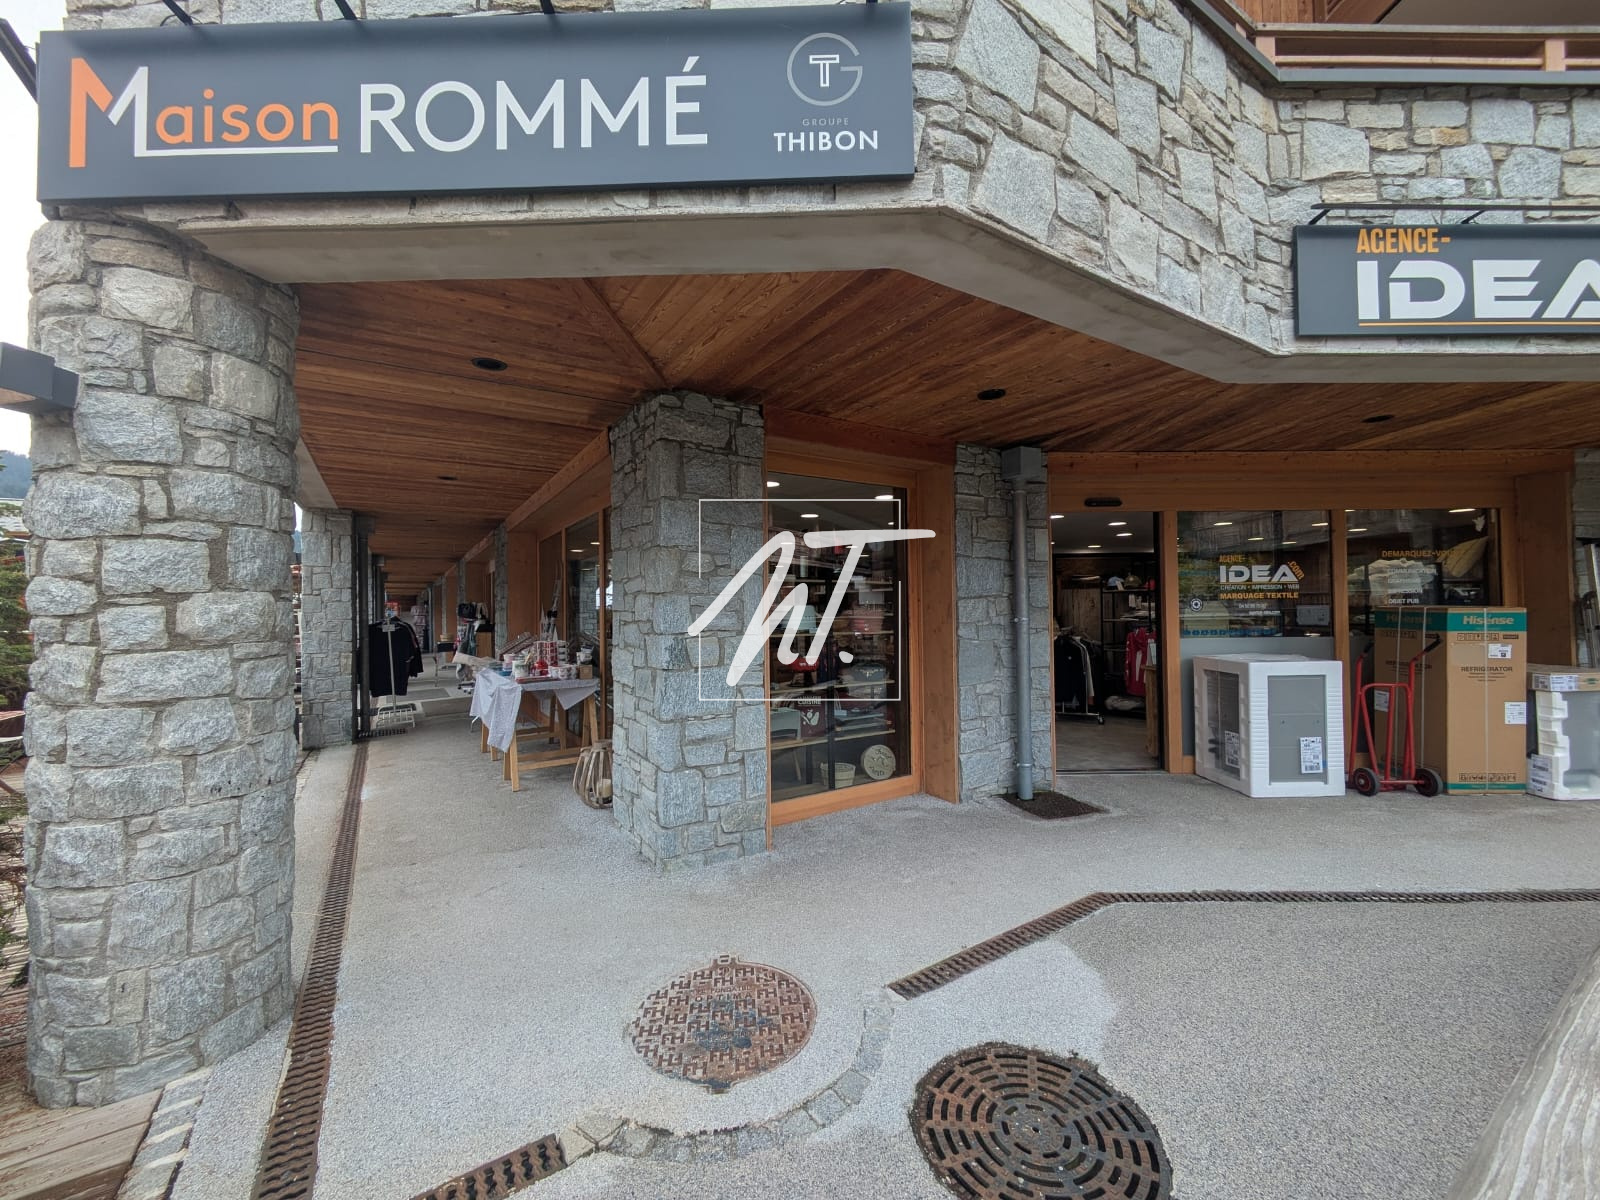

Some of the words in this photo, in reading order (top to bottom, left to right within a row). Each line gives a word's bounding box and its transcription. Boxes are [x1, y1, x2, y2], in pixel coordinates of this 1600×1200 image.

[69, 58, 339, 168] Maison
[360, 56, 708, 153] ROMMÉ
[802, 118, 849, 127] GROUPE
[774, 130, 879, 152] THIBON
[1220, 564, 1298, 583] IDEA
